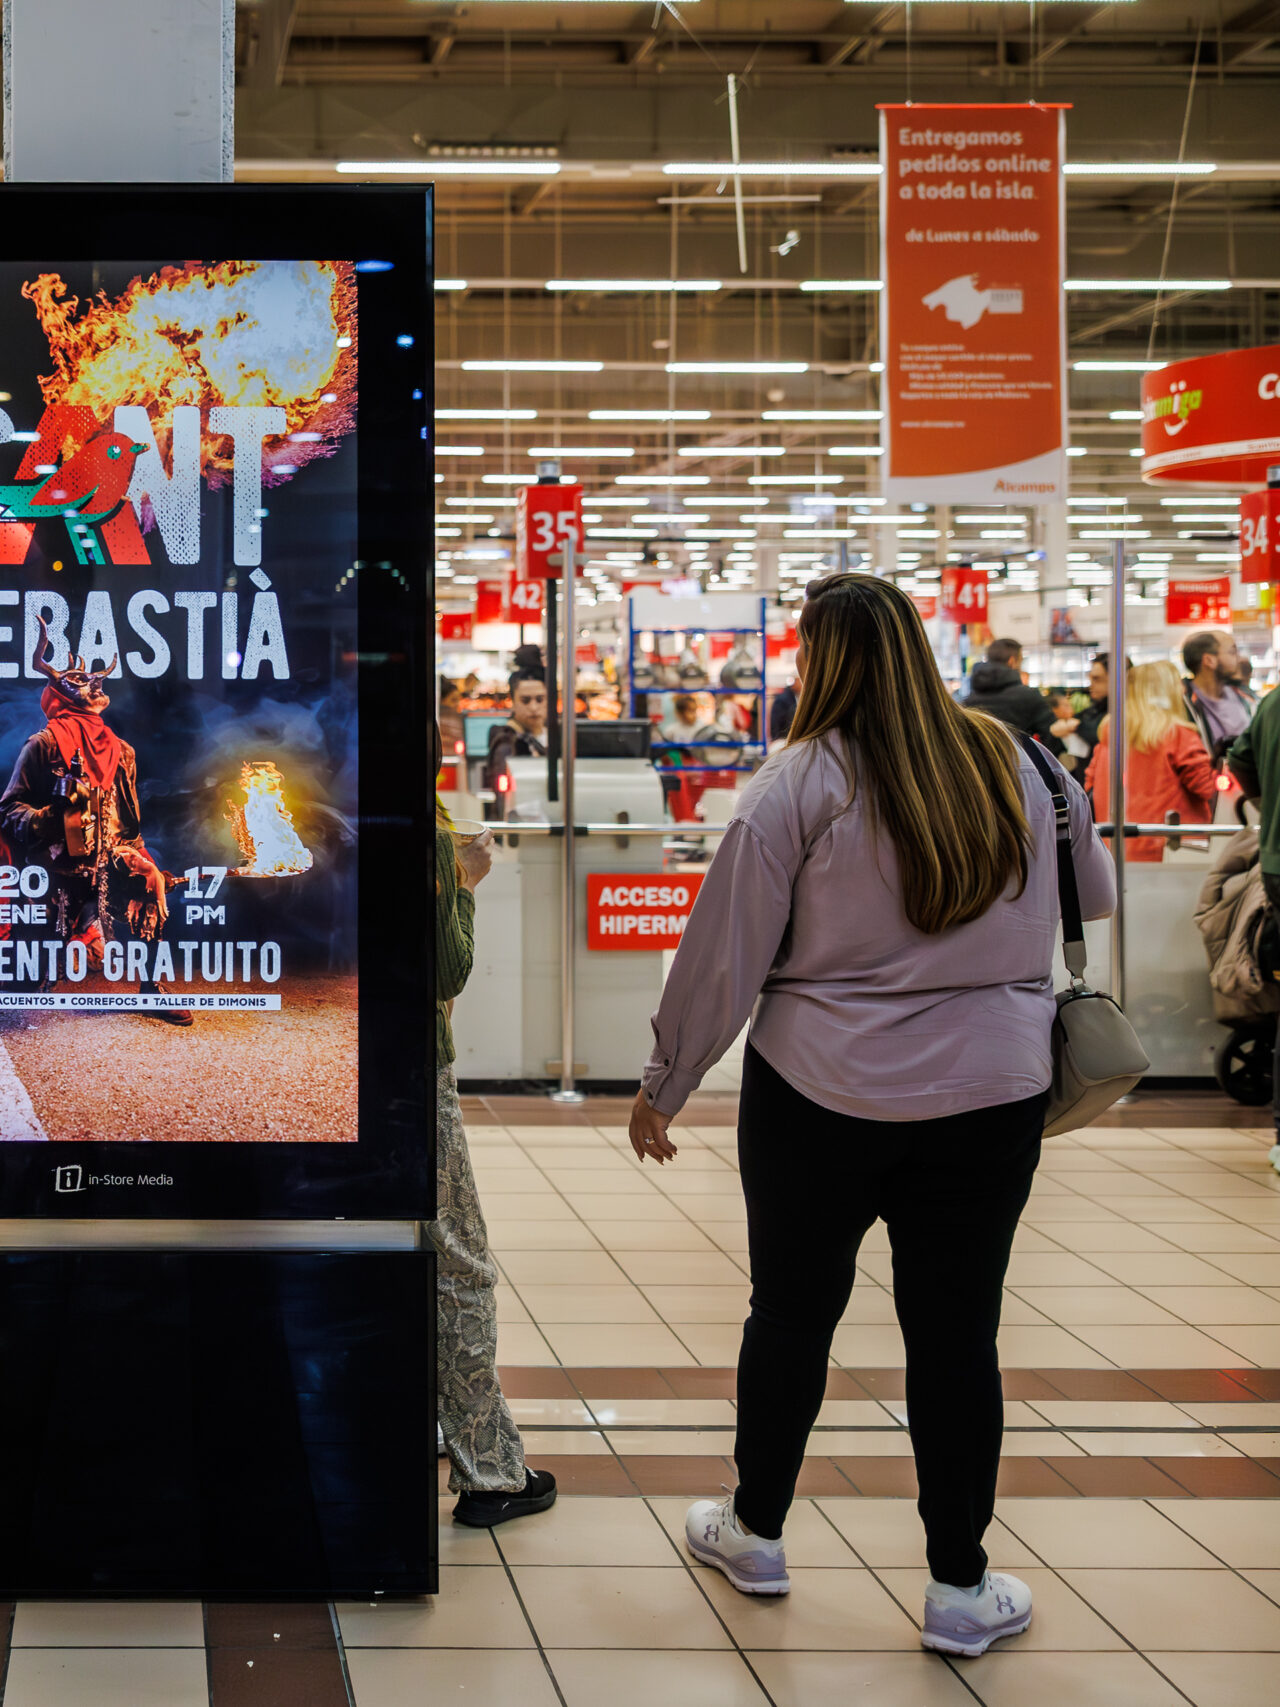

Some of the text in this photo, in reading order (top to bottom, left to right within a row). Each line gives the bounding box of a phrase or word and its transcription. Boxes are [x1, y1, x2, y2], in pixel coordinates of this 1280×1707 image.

[899, 128, 1023, 150] Entregamos
[899, 154, 1052, 177] pedidos online
[899, 185, 913, 199] a
[917, 181, 966, 199] toda
[971, 181, 991, 199] la
[905, 229, 923, 242] de
[927, 229, 969, 242] Lunes
[531, 511, 579, 552] 35
[1242, 515, 1269, 557] 34
[511, 583, 541, 609] 42
[958, 582, 986, 609] 41
[183, 866, 227, 899] 17
[598, 886, 690, 907] ACCESO
[186, 905, 225, 925] PM
[101, 940, 282, 983] GRATUITO
[70, 997, 138, 1006] CORREFOCS
[153, 997, 195, 1007] TALLER
[199, 997, 214, 1007] DE
[218, 997, 267, 1007] DIMONIS
[88, 1173, 174, 1186] in-Store Media
